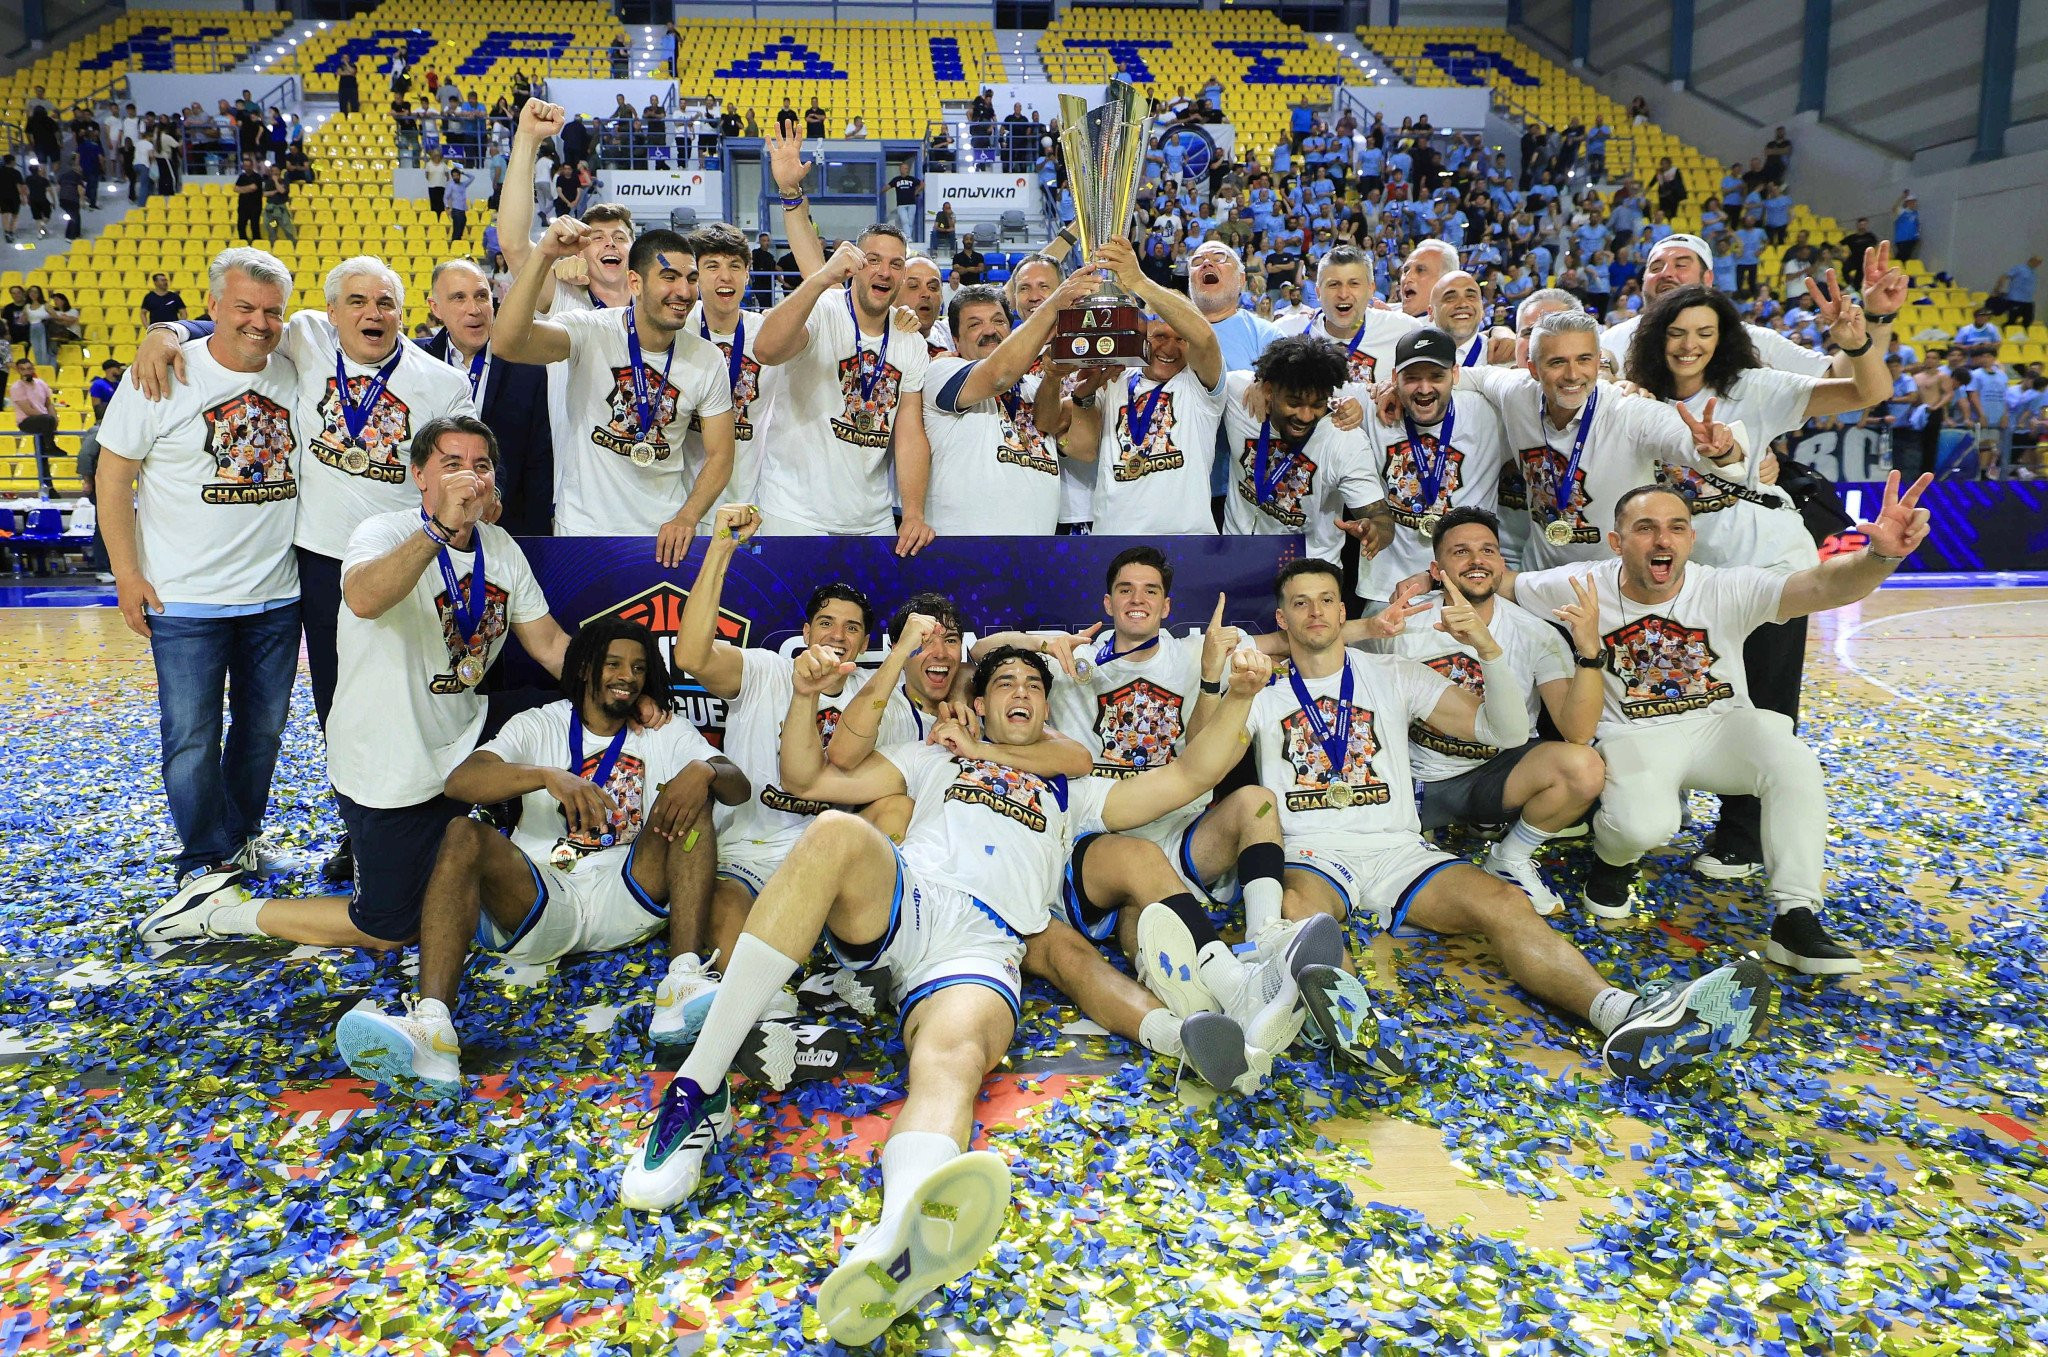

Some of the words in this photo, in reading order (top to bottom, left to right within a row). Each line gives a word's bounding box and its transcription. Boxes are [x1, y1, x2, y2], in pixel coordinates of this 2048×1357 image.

[592, 431, 669, 457] CHAMNS
[309, 444, 404, 482] CHAONS
[998, 449, 1057, 475] CHMIONS
[1114, 456, 1183, 480] CHPIONS
[203, 483, 296, 503] CHAMPIONS
[668, 696, 726, 728] GUE
[764, 790, 830, 815] CHAMPIO
[1287, 788, 1389, 812] CHAONS
